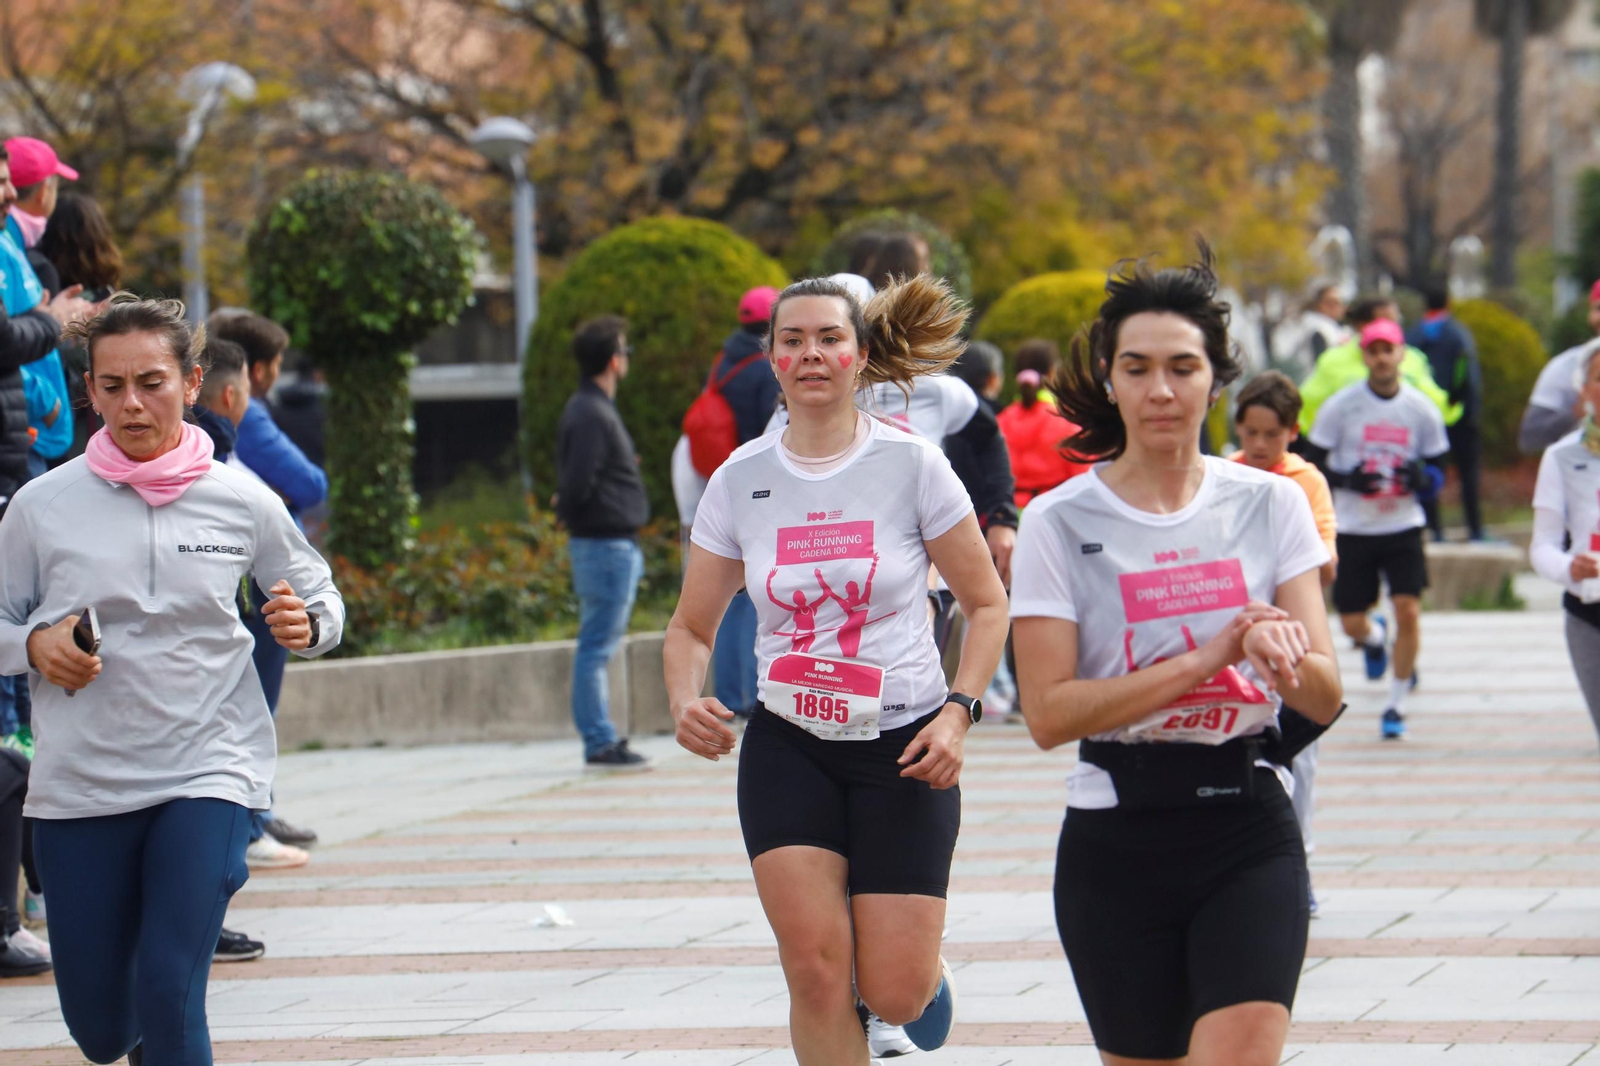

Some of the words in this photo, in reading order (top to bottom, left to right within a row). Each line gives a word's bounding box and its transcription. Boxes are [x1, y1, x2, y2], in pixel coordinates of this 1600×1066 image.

[807, 511, 826, 521] 100
[815, 529, 840, 537] Edición
[787, 539, 811, 550] PINK
[813, 534, 862, 547] RUNNING
[178, 545, 244, 555] BLACKSIDE
[800, 548, 831, 558] CADENA
[833, 546, 847, 555] 100
[1135, 585, 1169, 602] PINK
[1171, 576, 1234, 596] RUNNING
[1157, 596, 1199, 612] CADENA
[814, 661, 835, 673] 100
[804, 671, 818, 679] PINK
[818, 674, 843, 683] RUNNING
[792, 692, 849, 724] 1895
